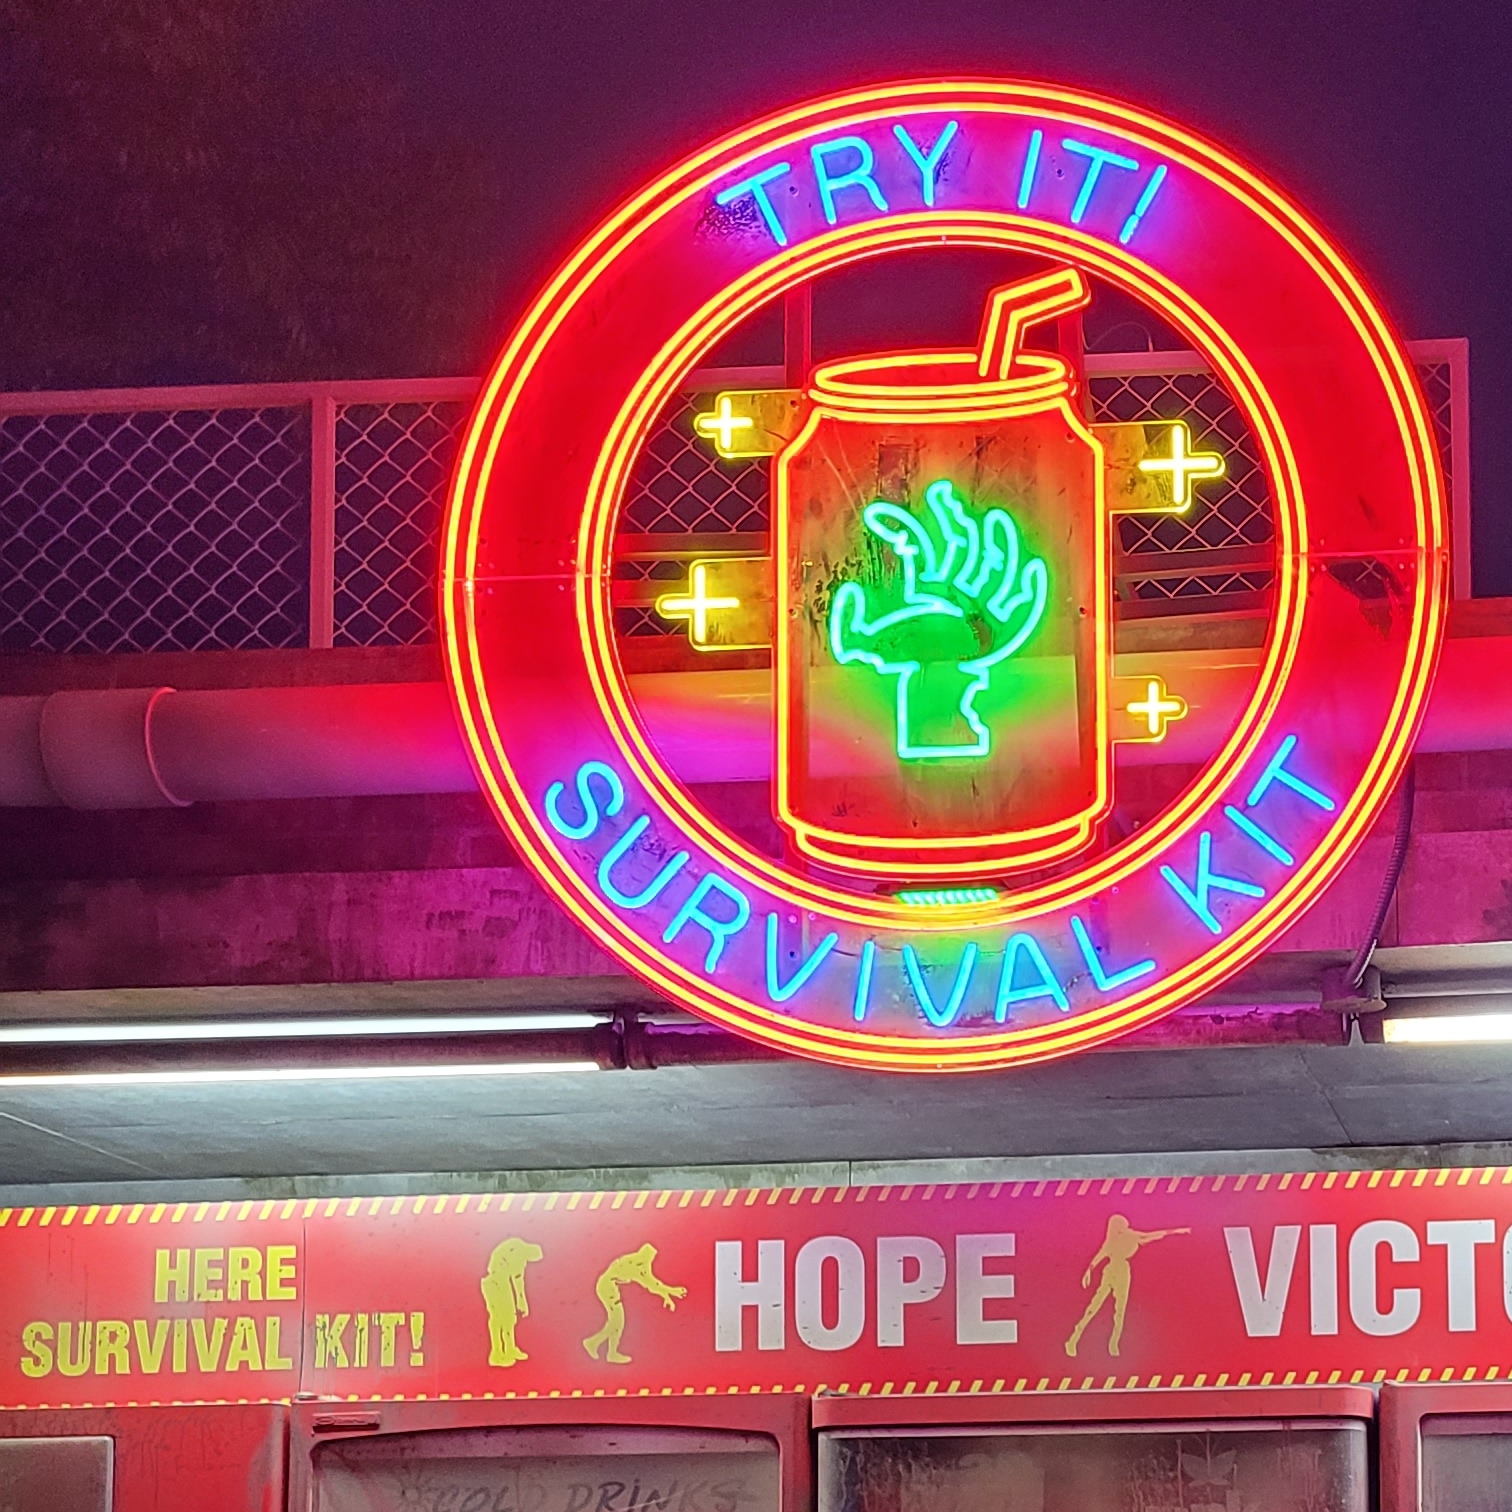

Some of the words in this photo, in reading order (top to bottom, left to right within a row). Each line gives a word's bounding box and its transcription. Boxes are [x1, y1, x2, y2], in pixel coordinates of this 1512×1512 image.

[717, 120, 959, 247] TRY
[1016, 129, 1168, 244] IT!
[545, 760, 1157, 1028] SURVIVAL
[1159, 735, 1336, 935] KIT
[154, 1244, 298, 1303] HERE
[714, 1232, 1019, 1352] HOPE
[19, 1316, 294, 1379] SURVIVAL
[313, 1311, 425, 1370] KIT!
